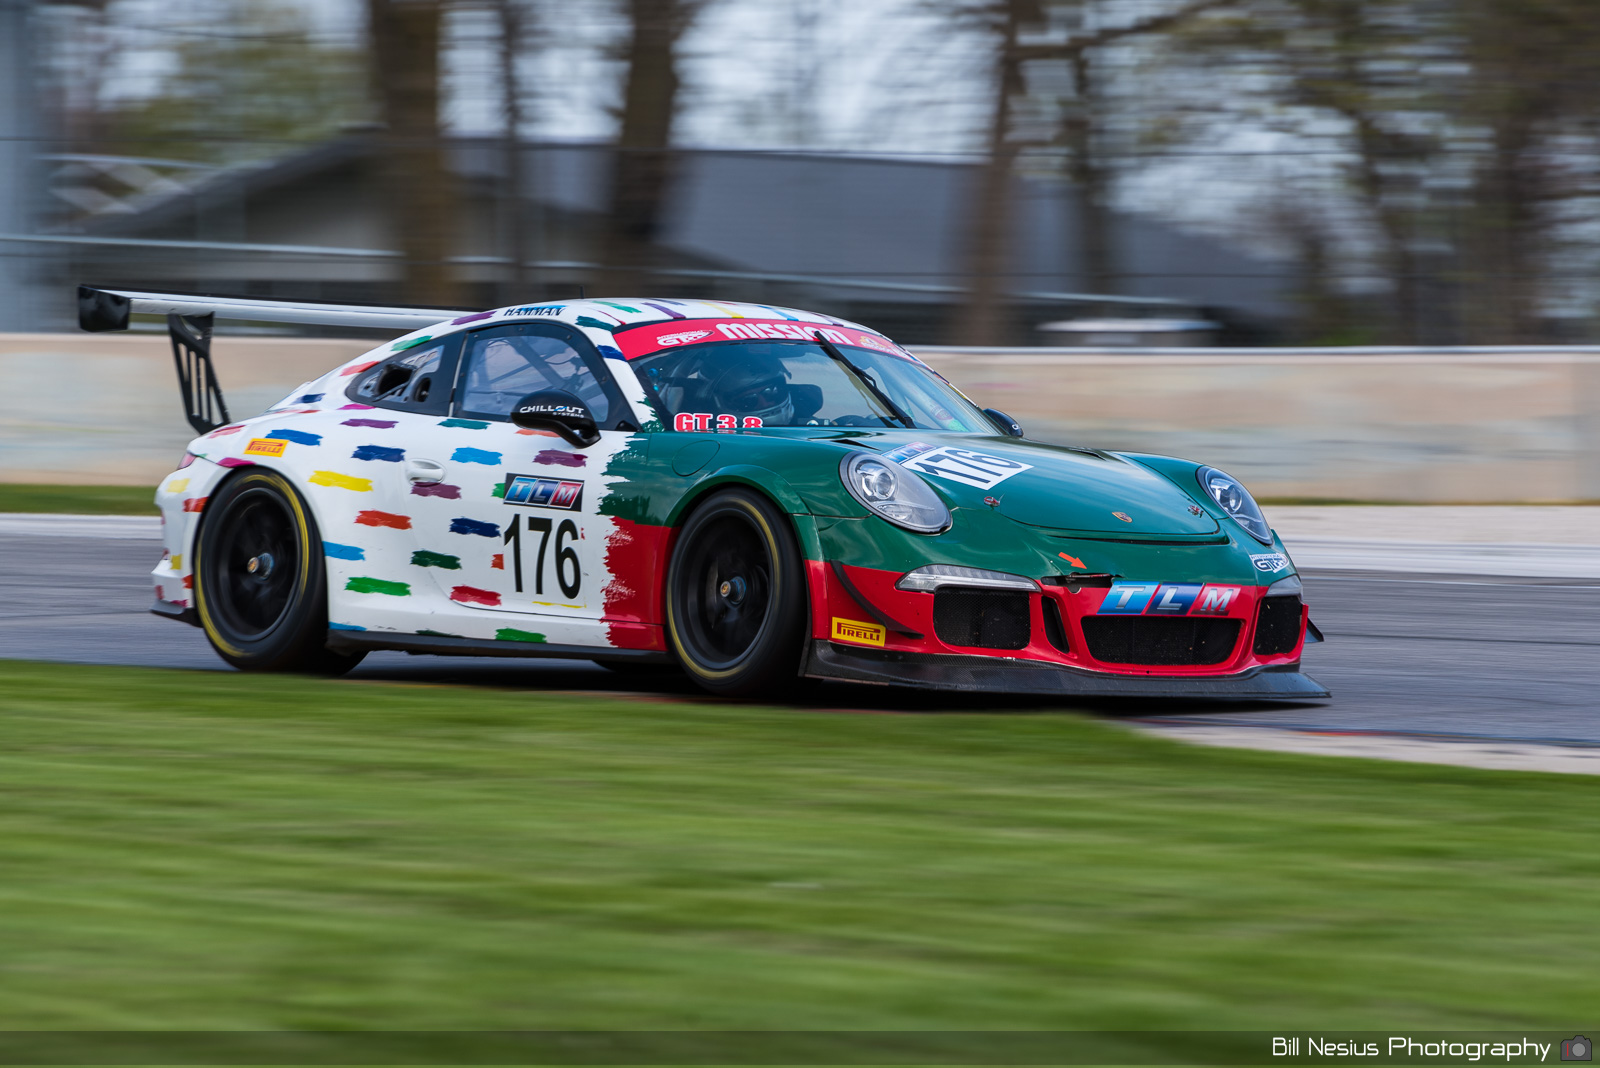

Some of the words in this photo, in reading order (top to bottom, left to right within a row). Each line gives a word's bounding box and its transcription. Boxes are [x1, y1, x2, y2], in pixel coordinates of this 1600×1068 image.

[519, 404, 585, 414] CHILLOUT
[674, 412, 713, 433] GT
[247, 440, 284, 454] PIRELLI
[914, 449, 1023, 484] 176
[504, 513, 581, 600] 176
[1114, 585, 1235, 612] TLM
[836, 621, 881, 642] PIRELLI
